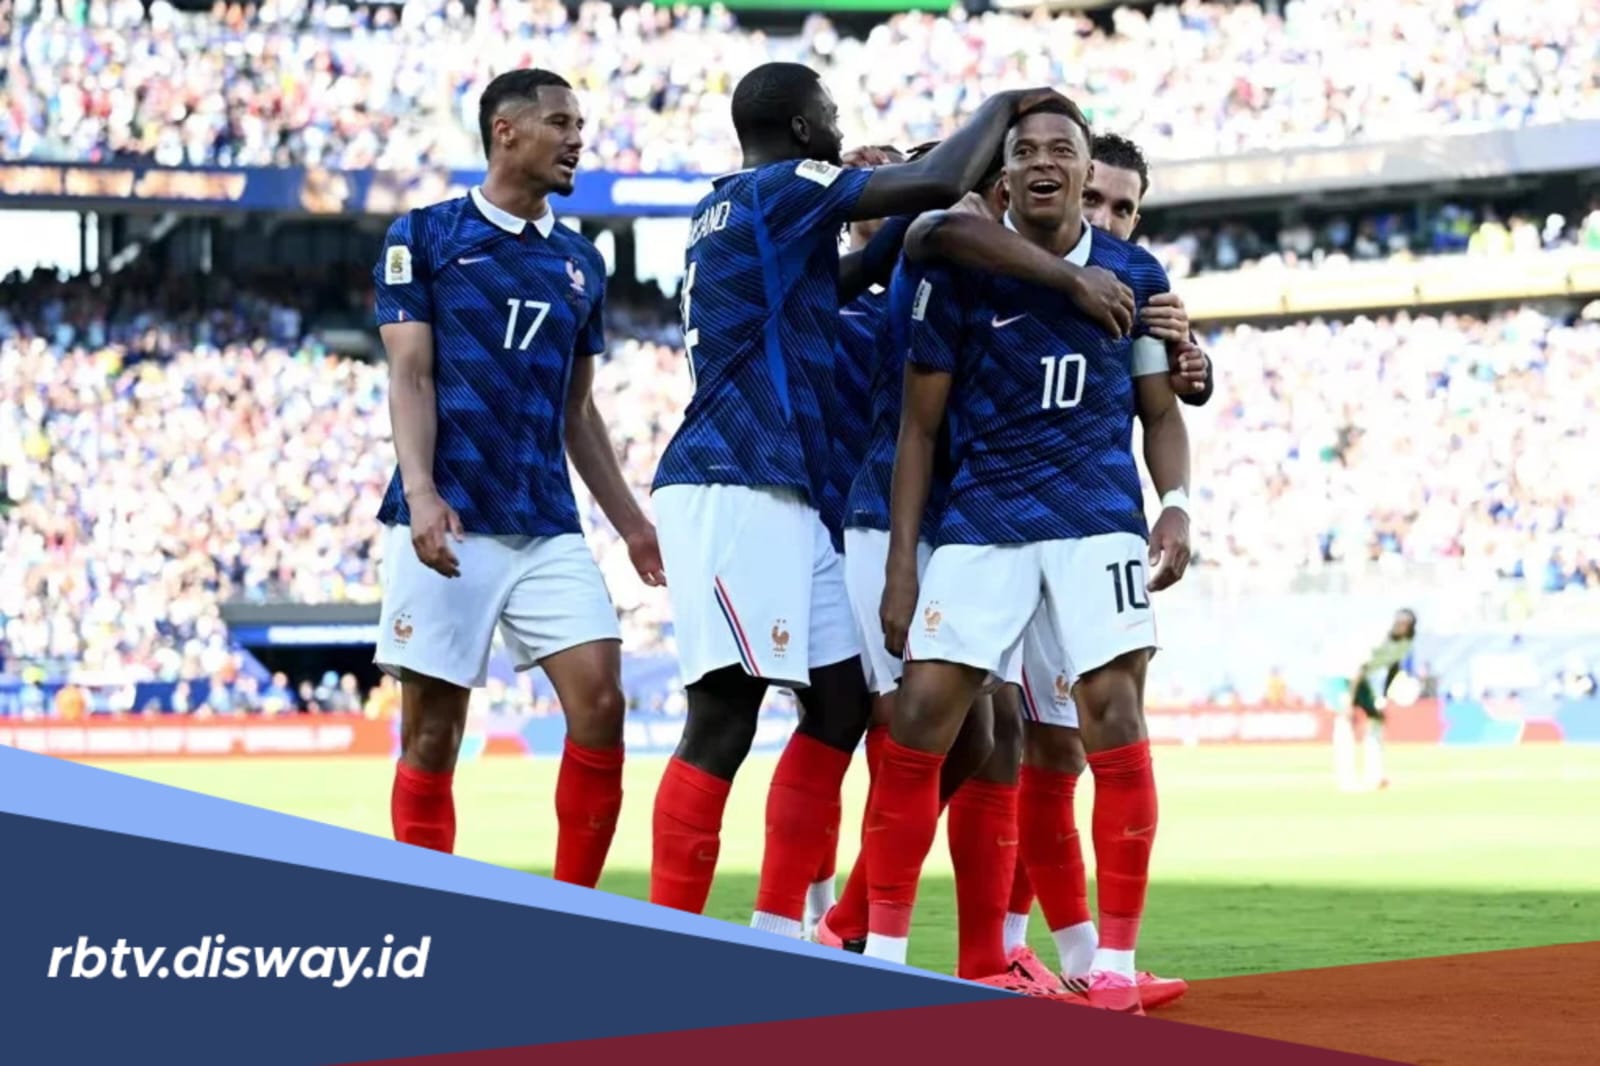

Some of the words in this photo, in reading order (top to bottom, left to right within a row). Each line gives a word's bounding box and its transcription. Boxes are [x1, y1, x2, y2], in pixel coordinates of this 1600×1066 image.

[504, 298, 551, 350] 17
[1041, 354, 1086, 409] 10
[1106, 560, 1150, 613] 10
